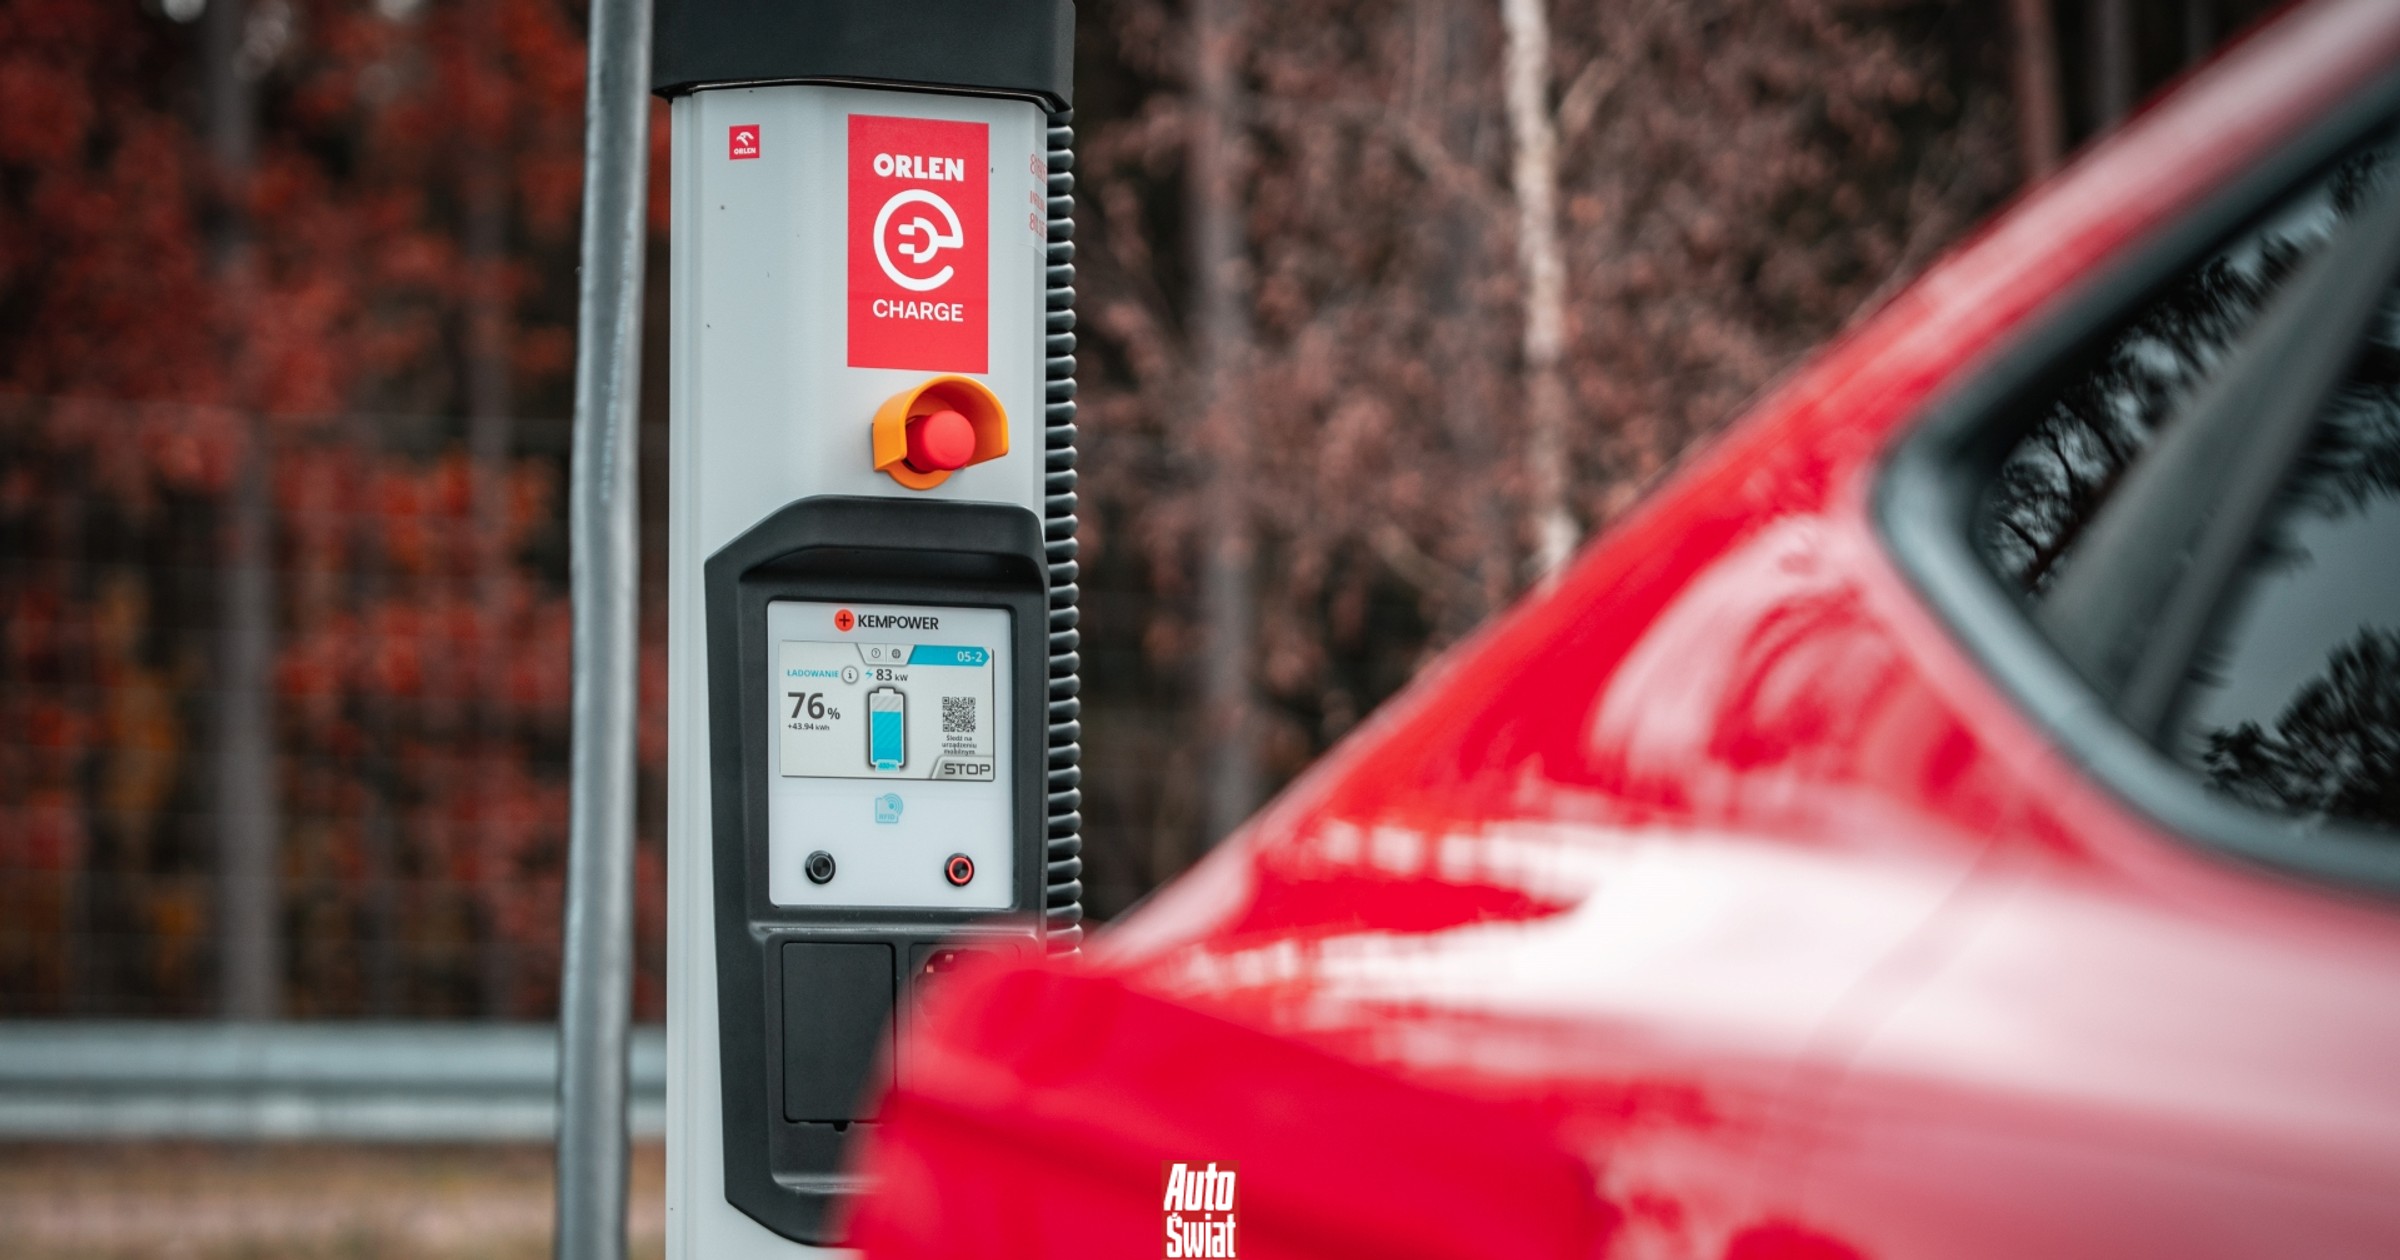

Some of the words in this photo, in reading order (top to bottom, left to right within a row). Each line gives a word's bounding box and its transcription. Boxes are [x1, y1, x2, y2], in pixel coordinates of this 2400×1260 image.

[733, 147, 756, 155] ORLEN
[873, 152, 964, 182] ORLEN
[872, 299, 964, 323] CHARGE
[858, 614, 939, 630] KEMPOWER
[957, 651, 983, 663] 05-2
[787, 669, 839, 678] ŁADOWANIE
[876, 668, 893, 681] 83
[895, 674, 908, 682] kW
[944, 763, 991, 775] STOP
